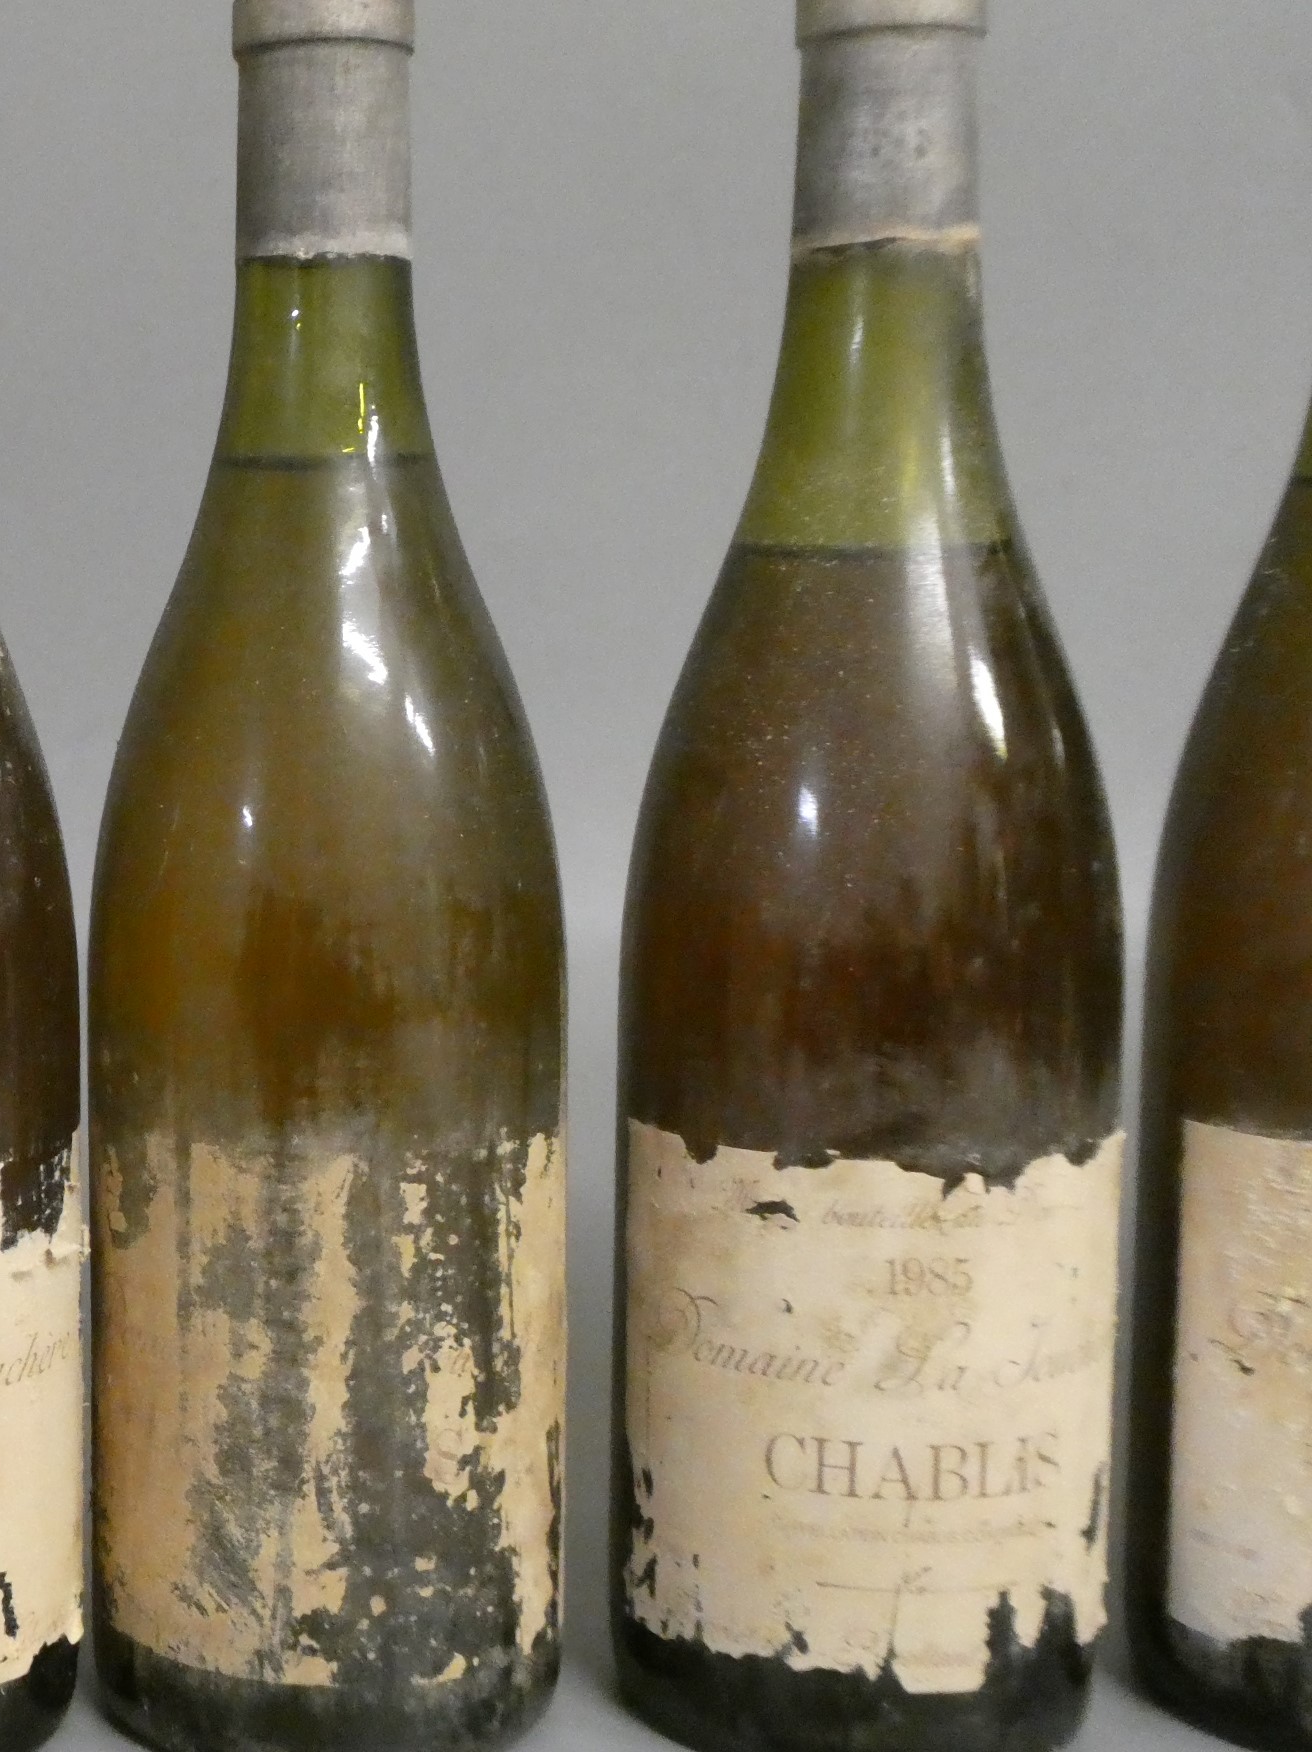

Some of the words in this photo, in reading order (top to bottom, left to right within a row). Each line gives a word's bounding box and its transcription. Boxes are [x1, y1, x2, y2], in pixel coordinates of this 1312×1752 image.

[885, 1258, 975, 1298] 1985
[653, 1287, 845, 1387] Domaine
[764, 1431, 1060, 1500] CHABLIS
